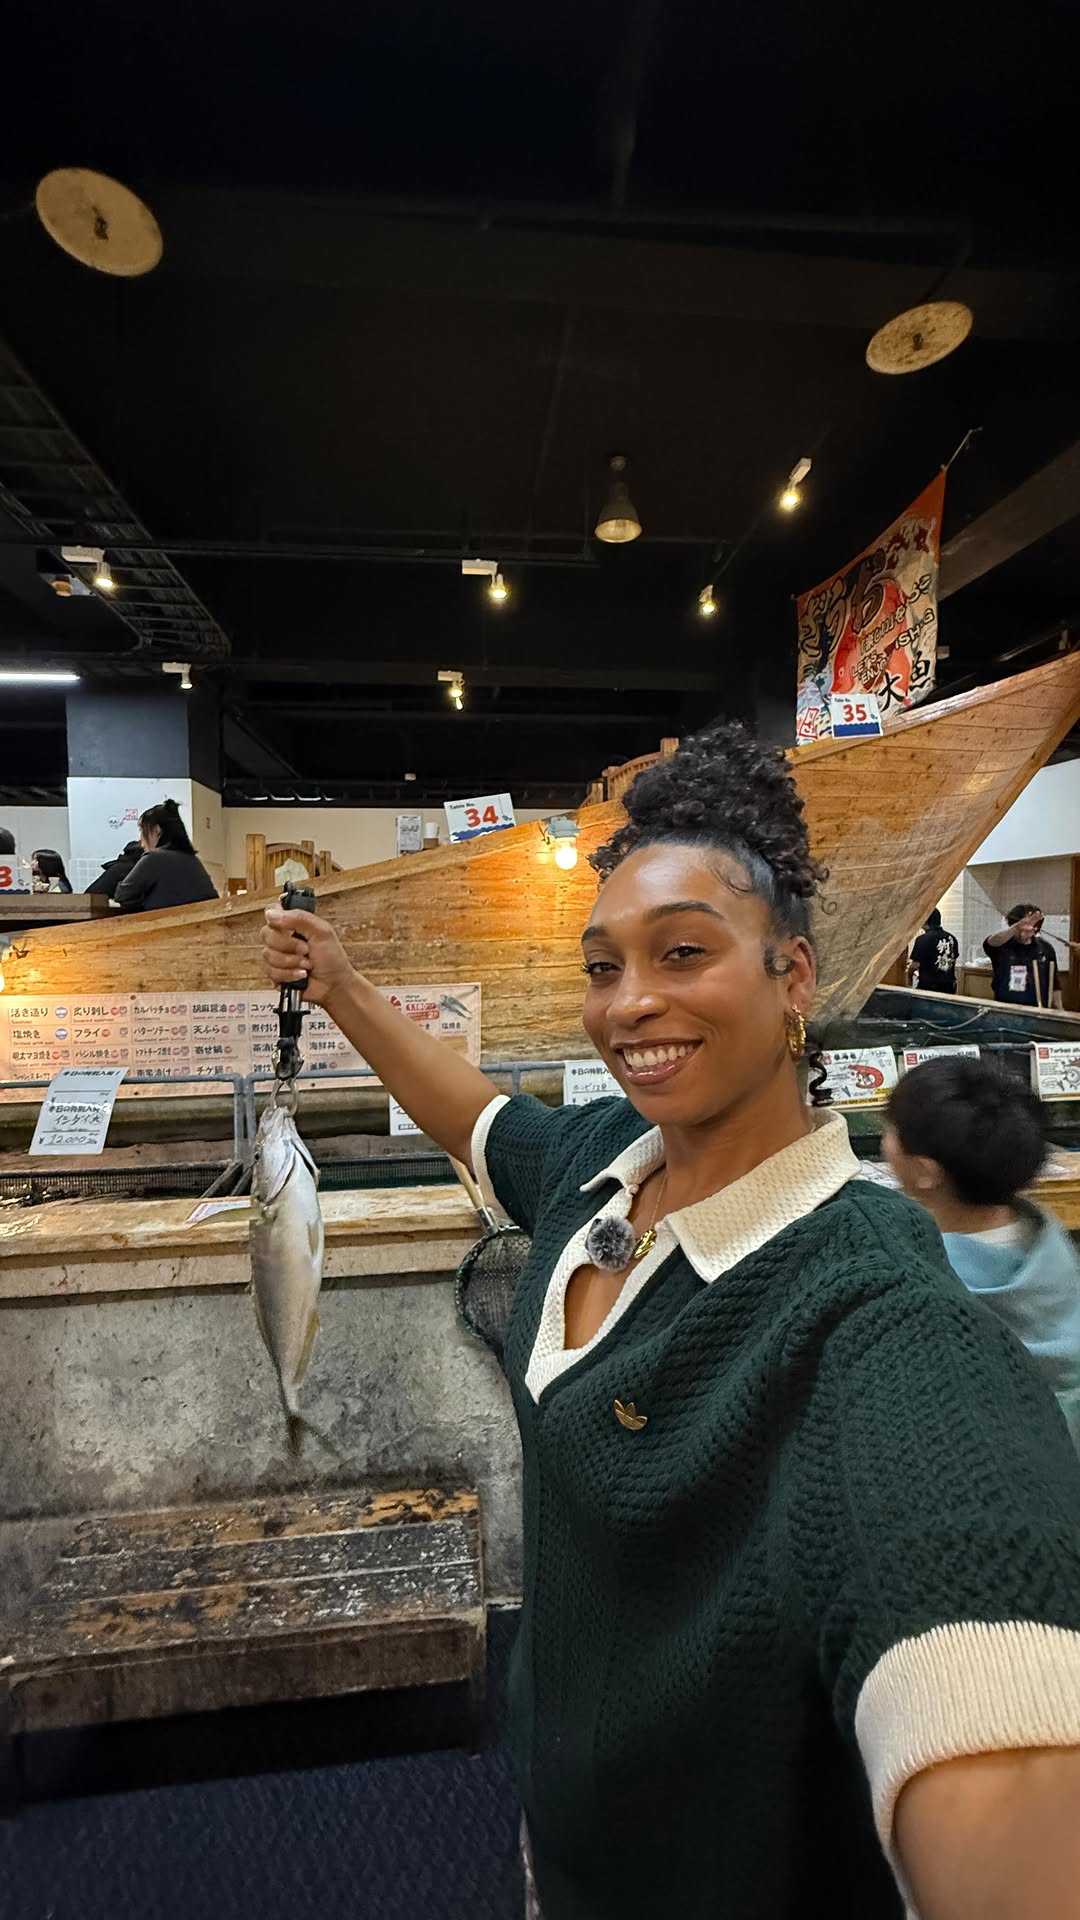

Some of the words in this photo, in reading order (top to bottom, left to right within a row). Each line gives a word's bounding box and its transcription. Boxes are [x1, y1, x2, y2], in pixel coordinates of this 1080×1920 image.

[843, 703, 867, 722] 35
[465, 805, 499, 828] 34
[73, 1028, 100, 1038] フライ
[193, 1025, 220, 1034] 天ぷら
